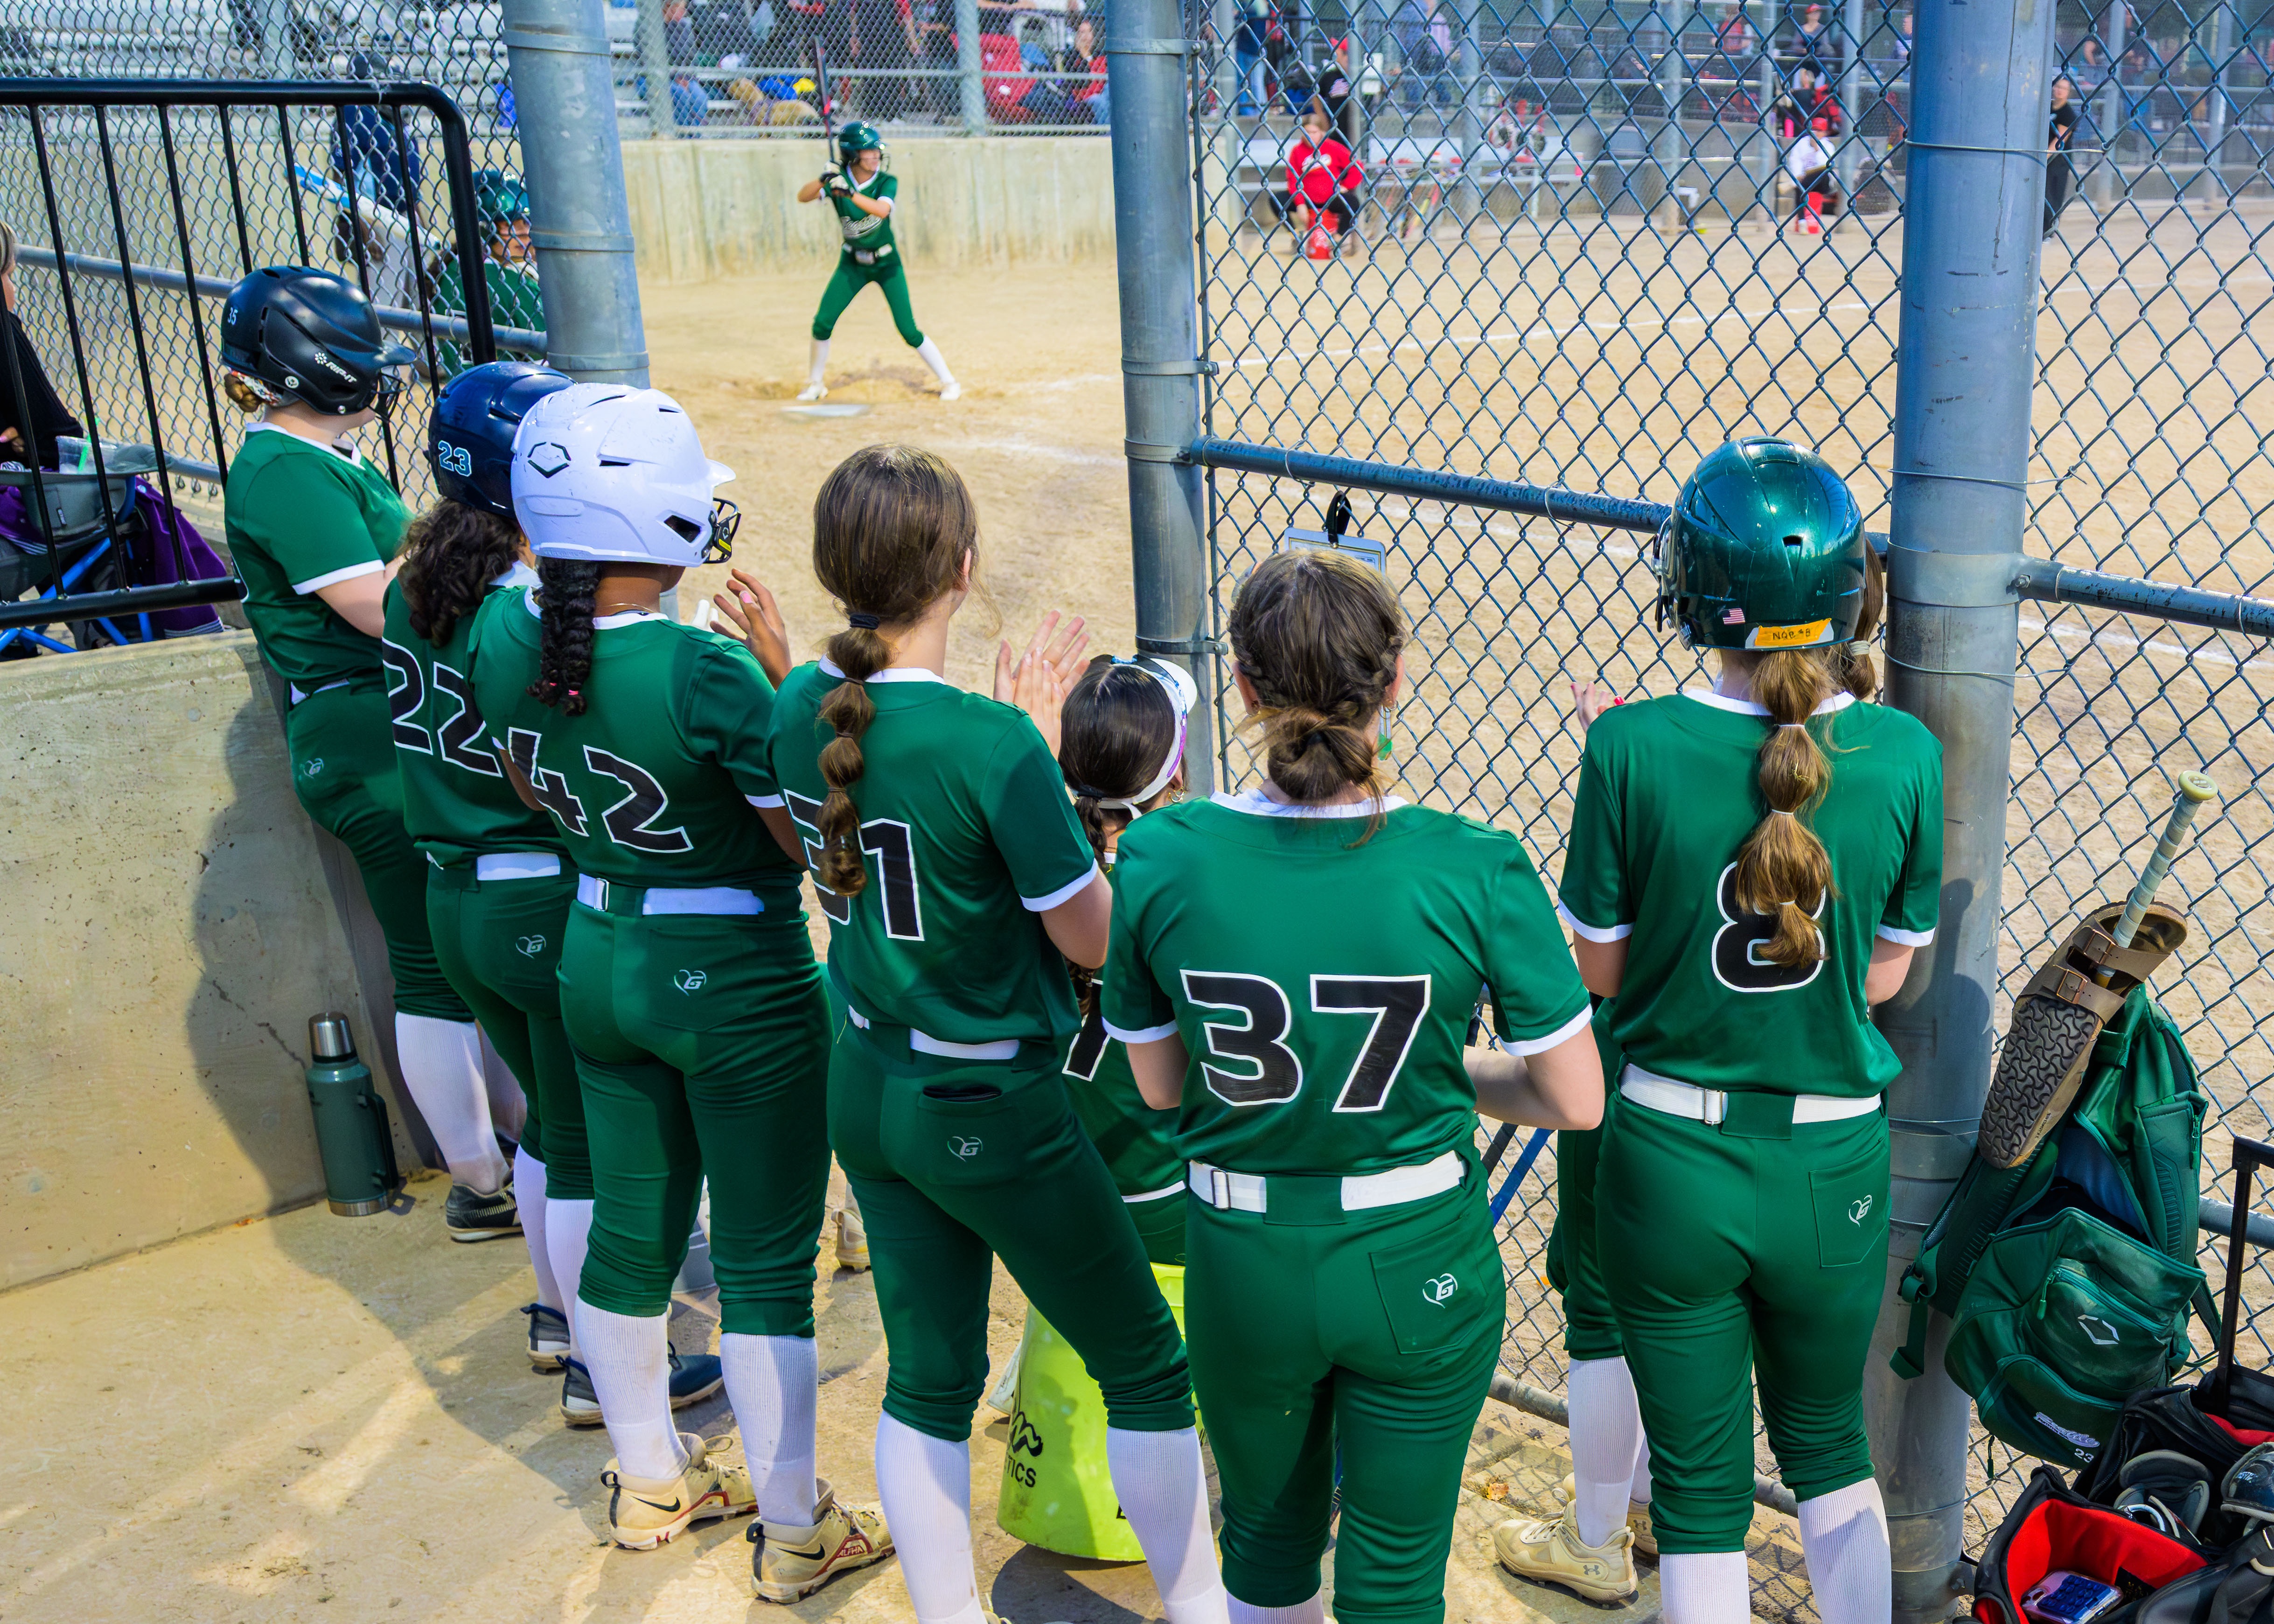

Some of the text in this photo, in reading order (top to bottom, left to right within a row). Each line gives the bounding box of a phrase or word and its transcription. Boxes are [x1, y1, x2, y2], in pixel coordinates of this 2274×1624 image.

[227, 307, 238, 325] 35
[438, 440, 472, 477] 23
[382, 637, 503, 778] 22
[507, 727, 694, 854] 42
[1711, 861, 1827, 993] 8
[1179, 969, 1432, 1113] 37
[2074, 1448, 2094, 1463] 23
